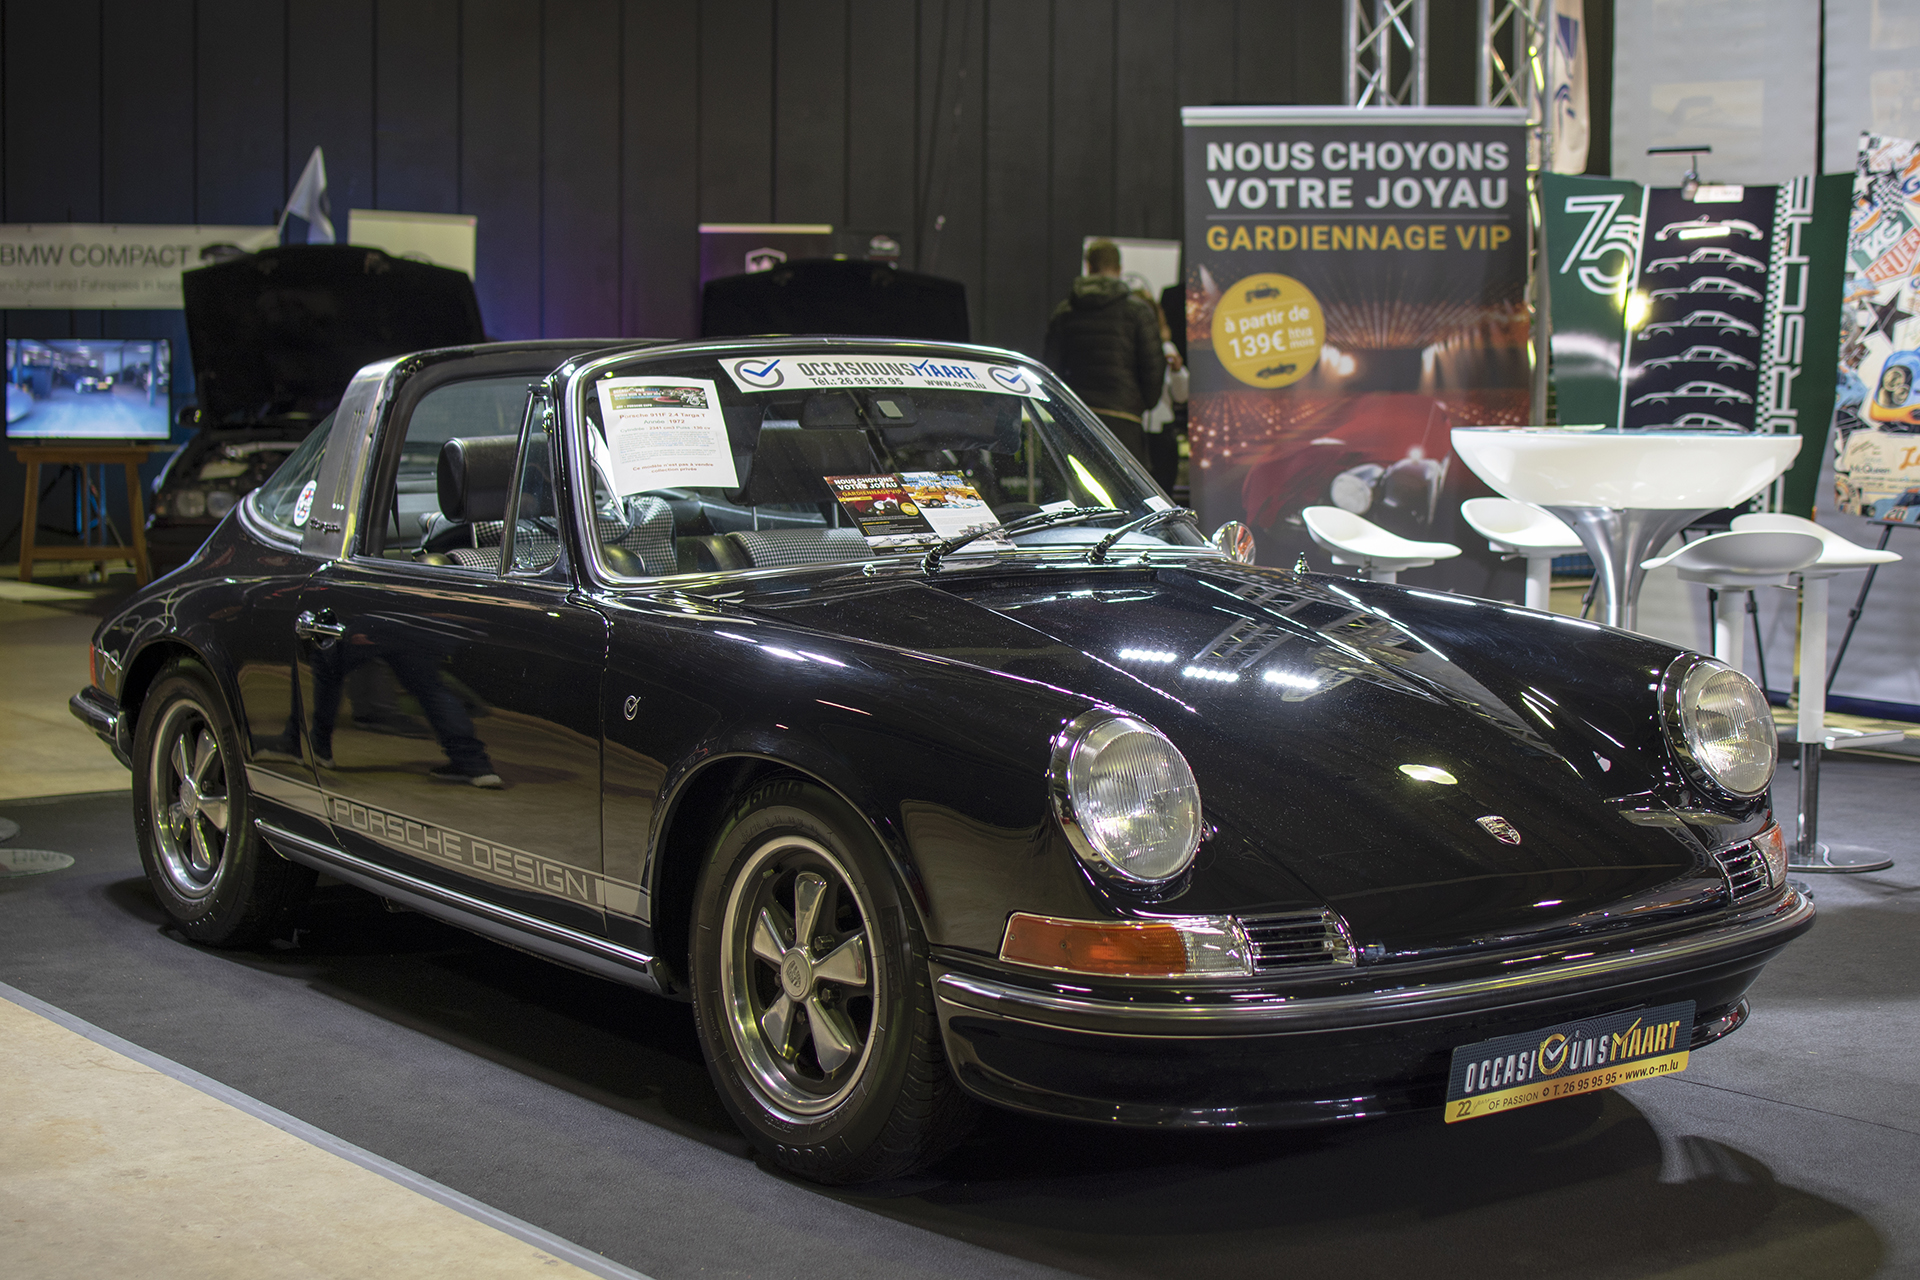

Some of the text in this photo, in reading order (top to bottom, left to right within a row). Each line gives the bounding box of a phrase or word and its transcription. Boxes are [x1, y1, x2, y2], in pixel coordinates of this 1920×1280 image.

[1206, 142, 1509, 171] NOUS CHOYONS
[1206, 178, 1509, 209] VOTRE JOYAU
[1206, 225, 1511, 251] GARDIENNAGE VIP
[1559, 193, 1641, 295] 75
[0, 243, 191, 267] BMW COMPACT
[1866, 228, 1920, 282] HEUER
[1239, 308, 1284, 334] partir
[1288, 306, 1310, 323] de
[1228, 330, 1285, 359] 139€
[1765, 174, 1816, 513] PRSCHE
[840, 377, 854, 386] 26
[856, 377, 871, 386] 95
[873, 377, 887, 386] 95
[890, 377, 904, 386] 95
[837, 483, 868, 491] VOTRE
[333, 799, 588, 900] PORSCHE DESIGN
[1456, 1100, 1472, 1118] 22
[1489, 1100, 1500, 1111] OF
[1503, 1091, 1539, 1107] PASSION
[1563, 1082, 1575, 1094] 26
[1577, 1078, 1589, 1091] 95
[1591, 1074, 1603, 1088] 95
[1605, 1071, 1617, 1084] 95
[1625, 1059, 1679, 1080] www.o-m.lu
